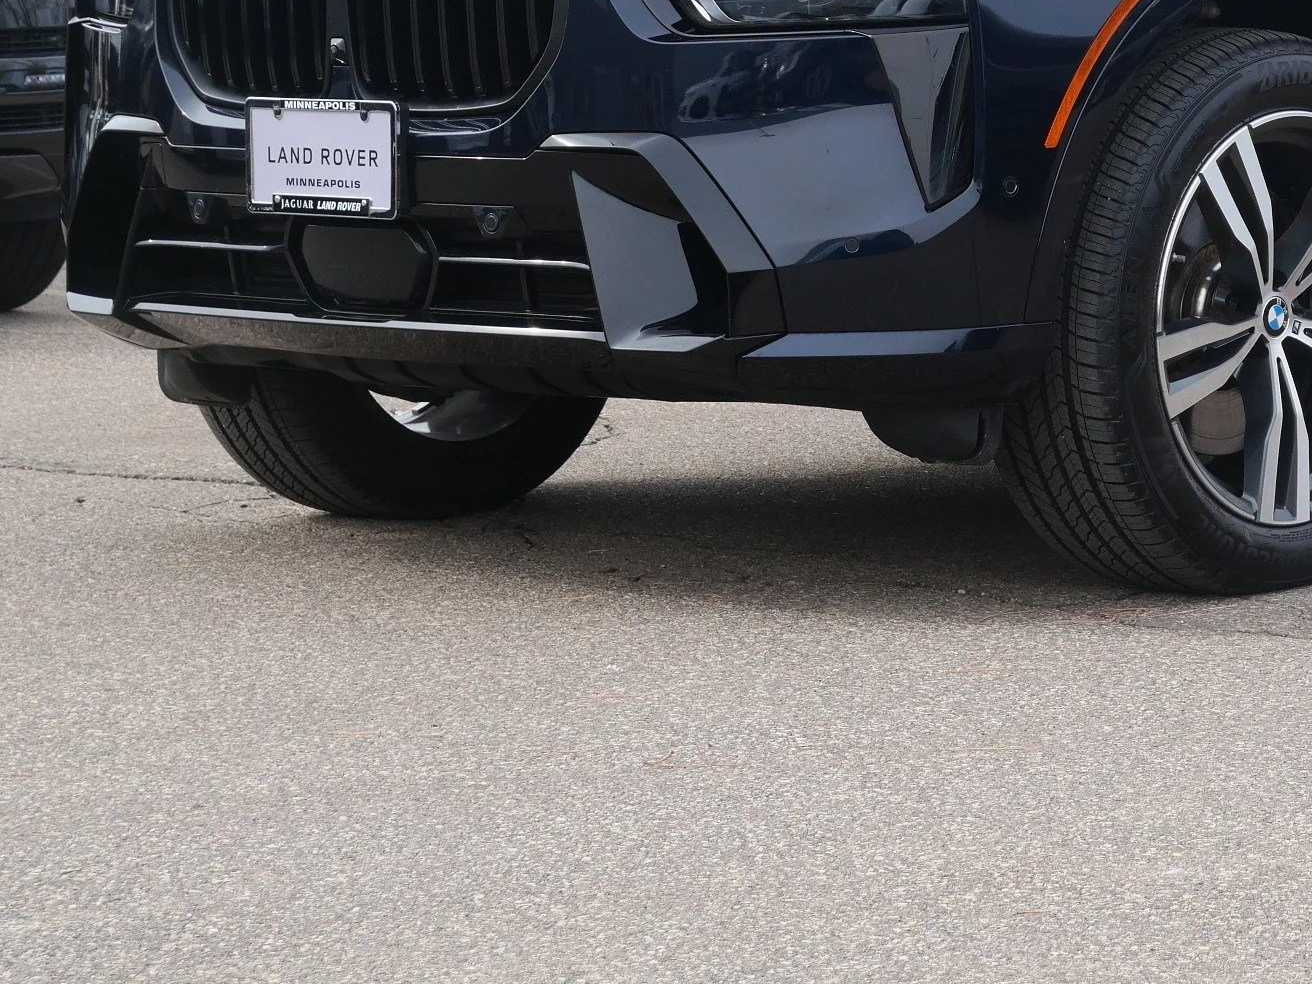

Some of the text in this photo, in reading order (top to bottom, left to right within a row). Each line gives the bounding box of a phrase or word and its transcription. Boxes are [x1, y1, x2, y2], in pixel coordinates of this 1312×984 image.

[284, 100, 356, 111] MINNEAPOLIS
[267, 146, 379, 167] LAND ROVER
[285, 177, 361, 189] MINNEAPOLIS
[281, 198, 314, 209] JAGUAR
[316, 200, 337, 210] LAND
[337, 201, 362, 212] ROVER
